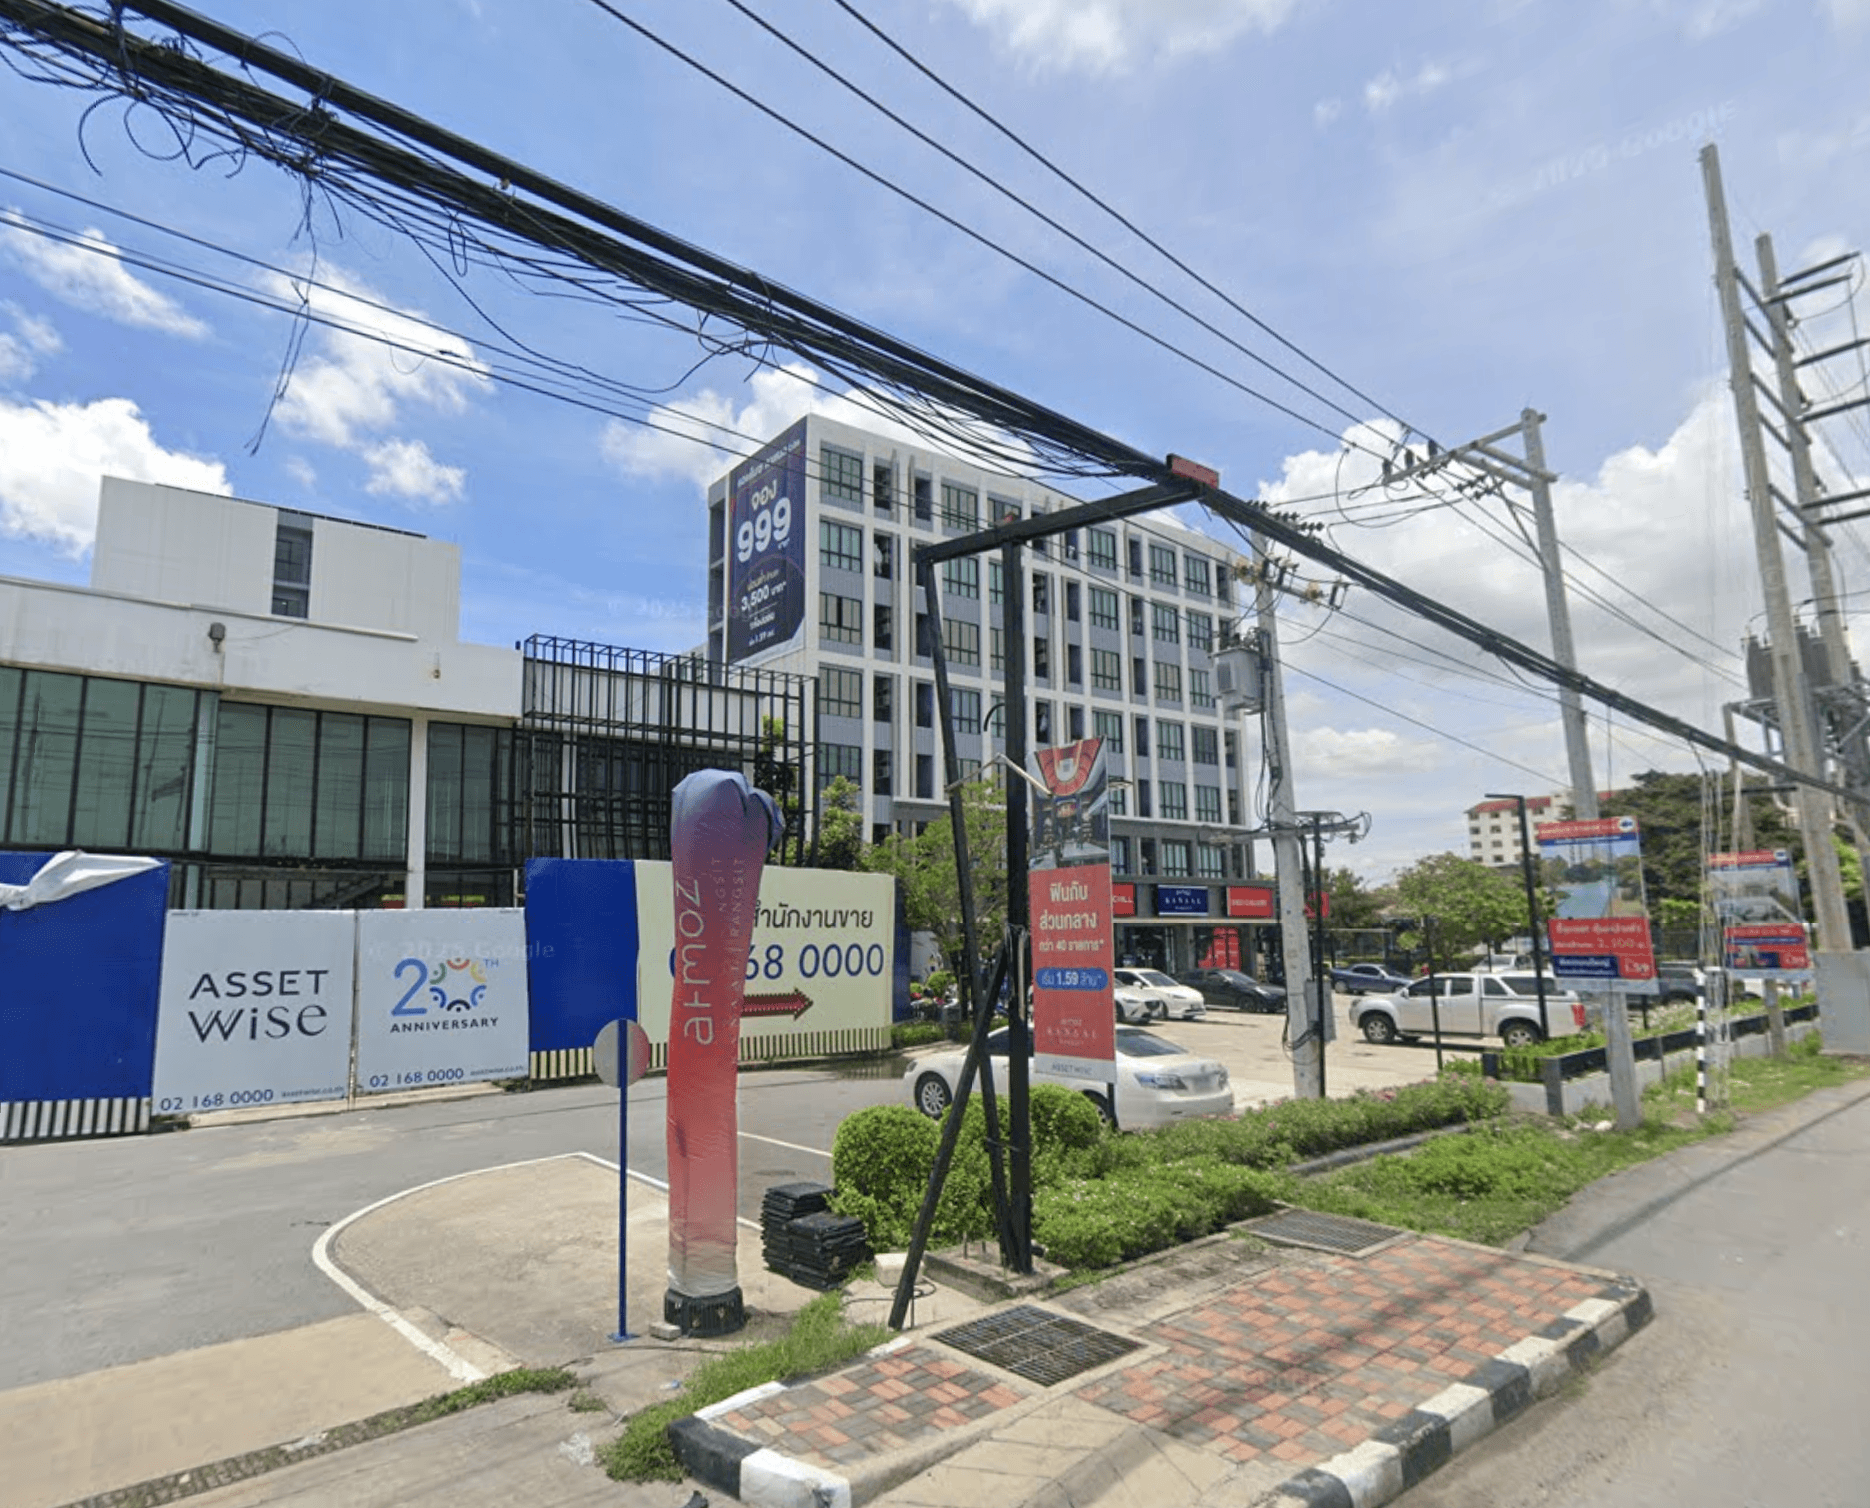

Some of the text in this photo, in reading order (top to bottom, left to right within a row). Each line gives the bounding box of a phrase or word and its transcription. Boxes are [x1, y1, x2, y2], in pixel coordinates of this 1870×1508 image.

[737, 497, 792, 563] 999
[754, 899, 874, 929] ำนักงานขาย
[745, 943, 885, 980] 68 0000
[189, 969, 329, 1000] ASSET
[1056, 970, 1079, 985] 1.59
[391, 1017, 499, 1034] ANNIVERSARY
[369, 1075, 389, 1088] 02
[396, 1072, 423, 1085] 168
[427, 1068, 465, 1082] 0000
[160, 1097, 183, 1111] 02
[192, 1093, 225, 1108] 168
[230, 1089, 274, 1104] 0000
